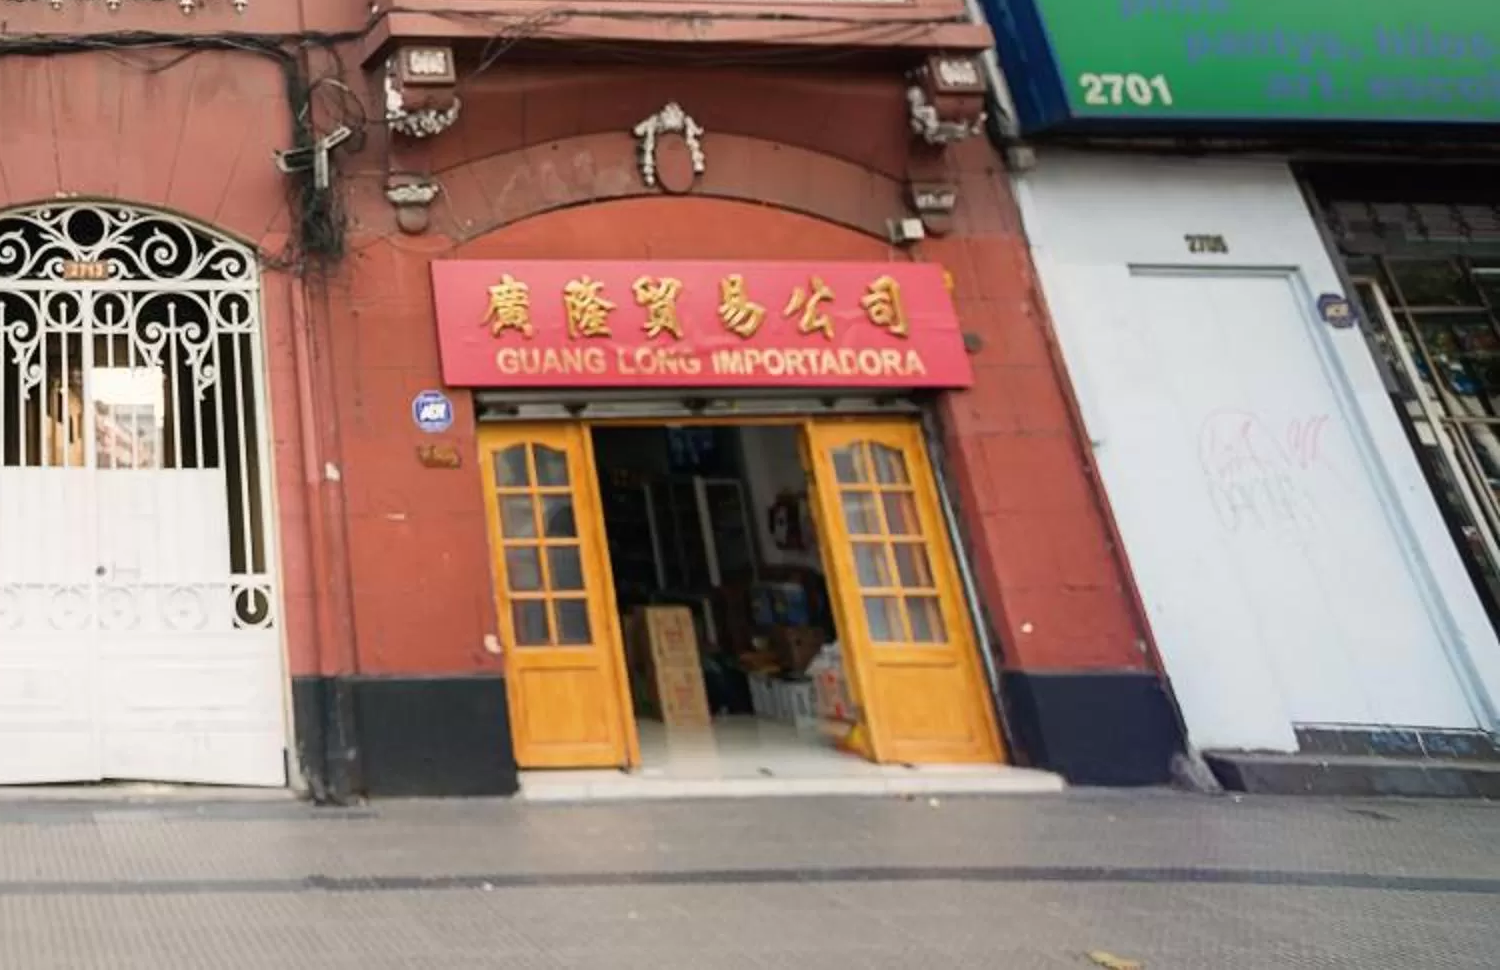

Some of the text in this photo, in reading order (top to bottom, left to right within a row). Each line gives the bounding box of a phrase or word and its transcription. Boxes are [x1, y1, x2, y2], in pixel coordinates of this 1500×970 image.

[1079, 72, 1173, 106] 2701
[482, 272, 910, 340] 廣隆貿易公司
[497, 346, 927, 377] GUANG LONG IMPORTADORA
